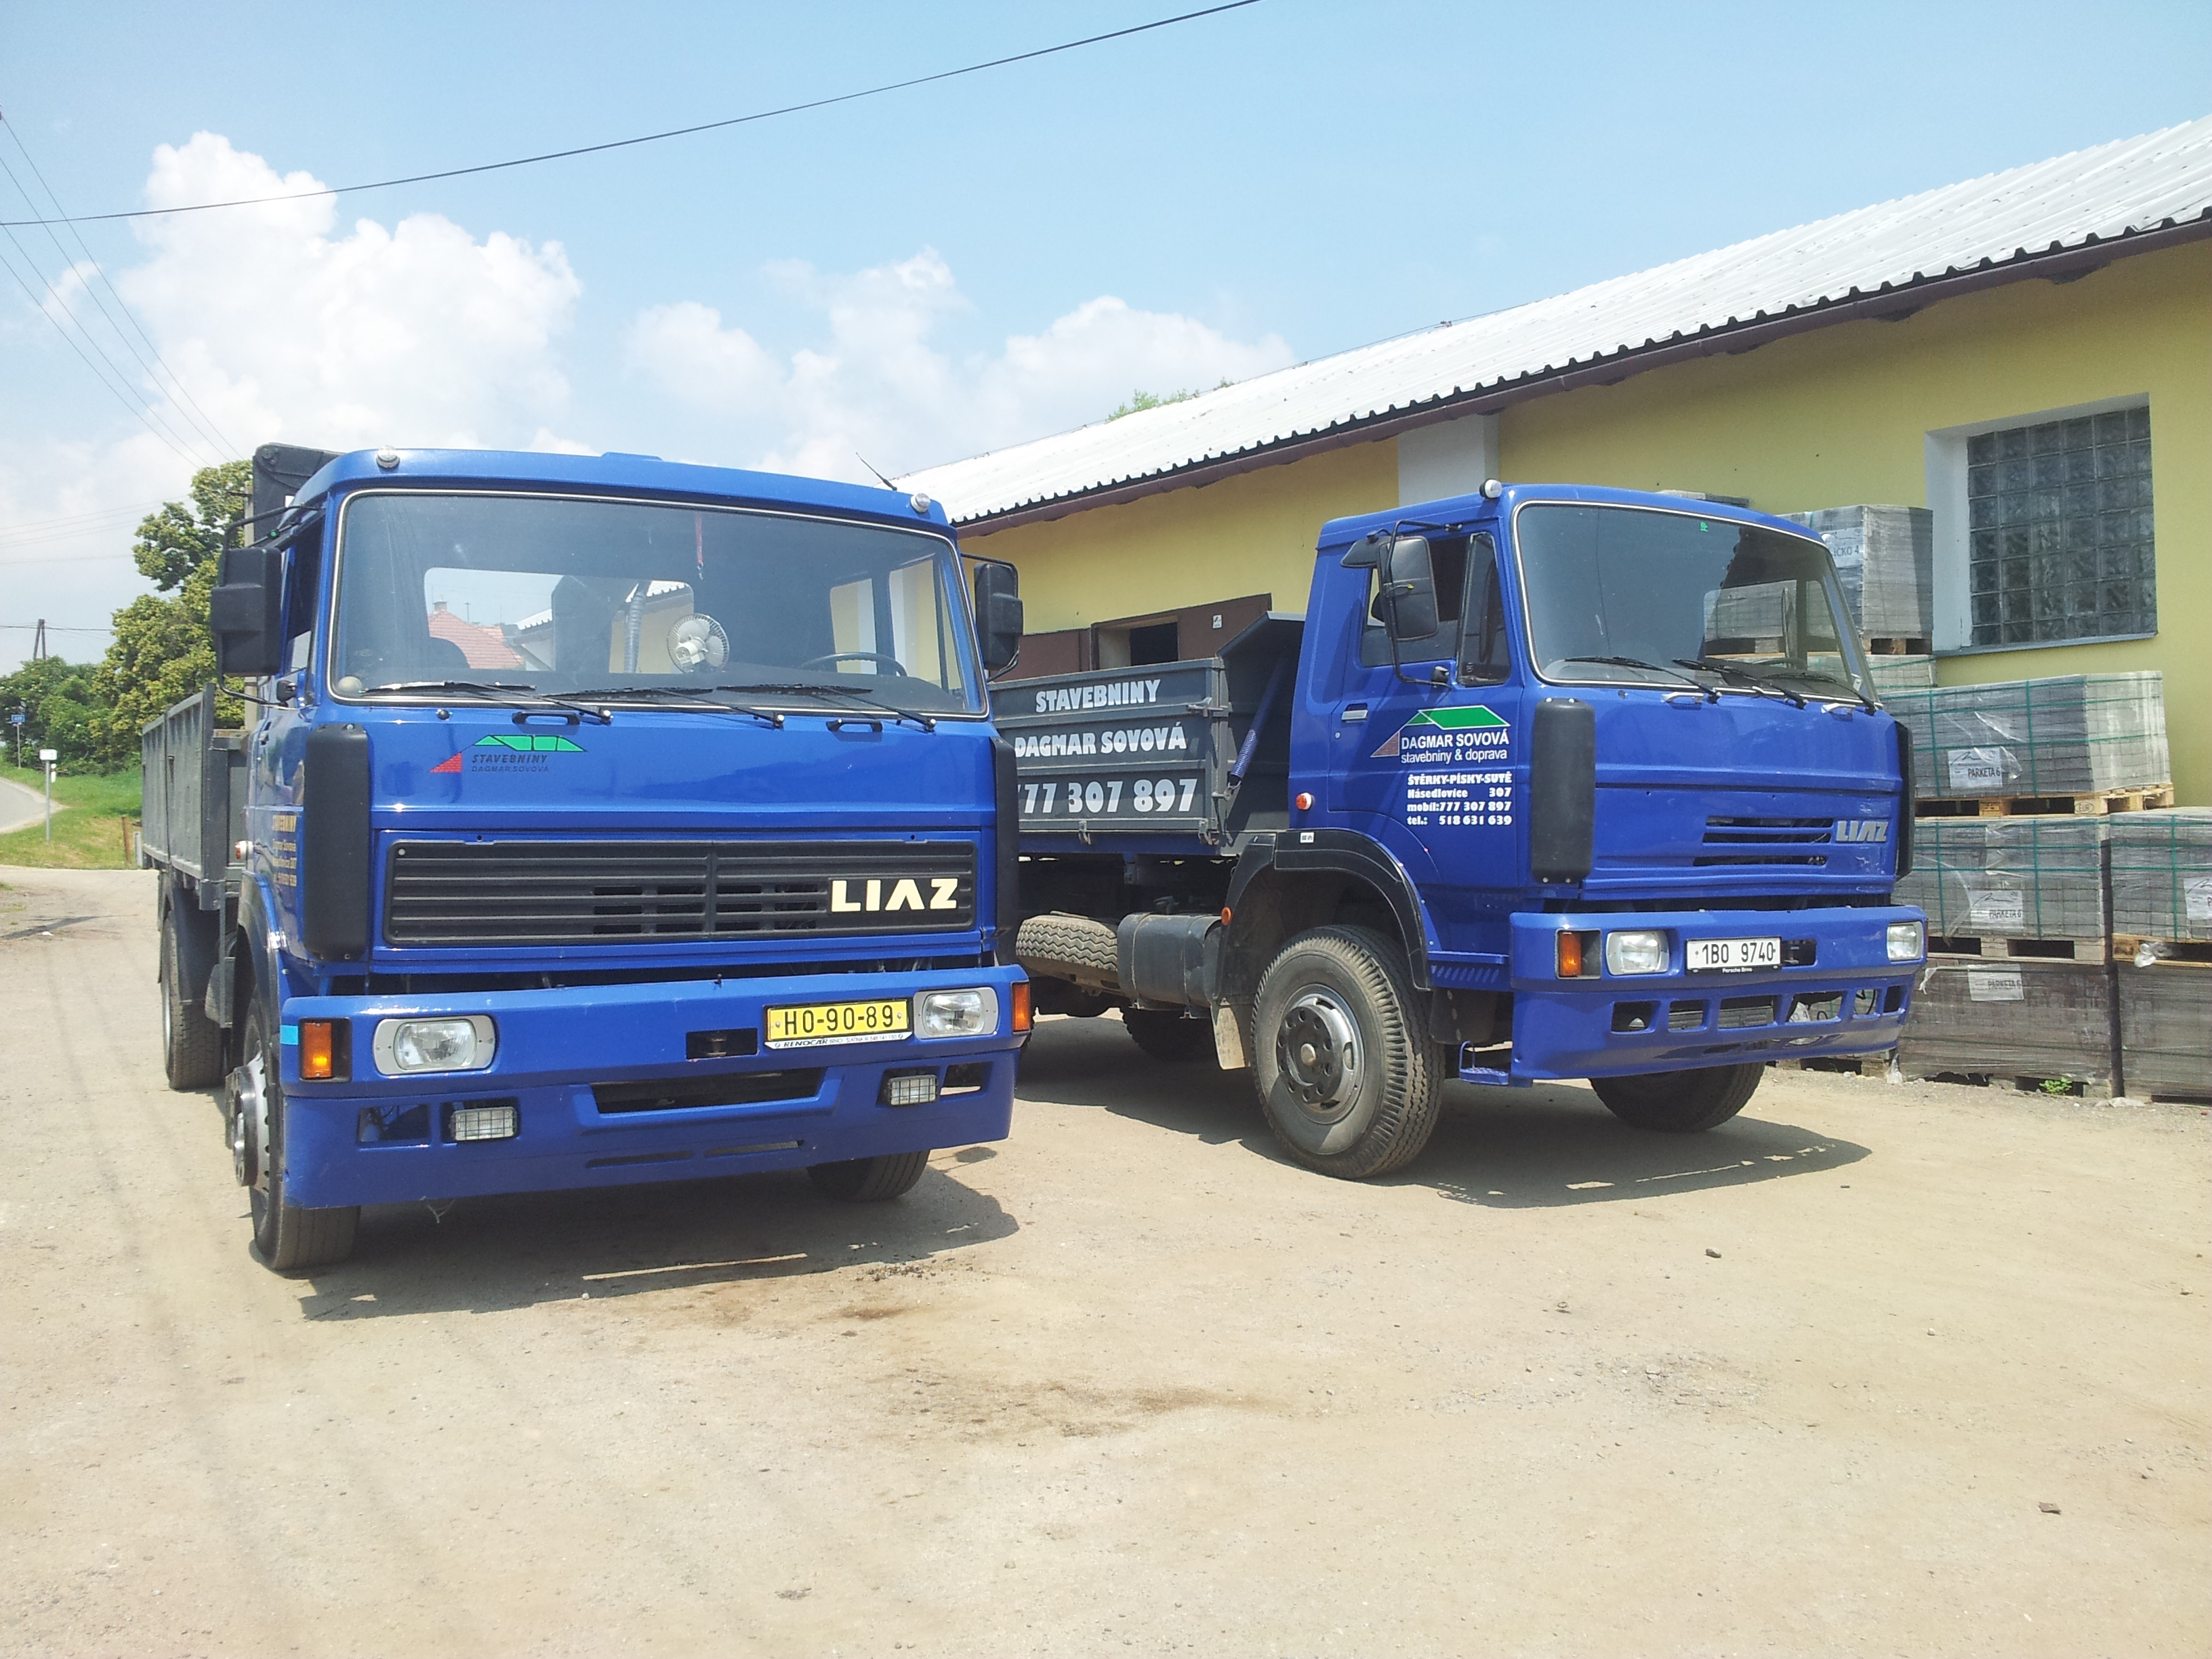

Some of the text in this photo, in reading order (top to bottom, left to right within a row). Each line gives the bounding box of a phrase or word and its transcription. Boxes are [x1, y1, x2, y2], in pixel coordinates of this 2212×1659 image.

[1854, 545, 1860, 554] 4
[1036, 679, 1161, 713] STAVEBNINY
[1015, 722, 1187, 758] DAGMAR SOVOVÁ
[1401, 729, 1510, 750] DAGMAR SOVOVÁ
[472, 754, 548, 764] STAVEBNINY
[1401, 747, 1508, 764] stavebniny & doprava
[1967, 767, 1995, 779] PARKETA
[1996, 766, 2001, 777] 6
[1017, 779, 1198, 814] 77 307 897
[1407, 787, 1512, 799] Násedlovice 307
[1463, 801, 1486, 811] 307
[1488, 801, 1512, 811] 897
[1406, 815, 1513, 825] tel.: 518 631 639
[1835, 820, 1889, 842] LIAZ
[831, 878, 958, 912] LIAZ
[1740, 941, 1774, 963] 9740
[785, 1004, 894, 1036] HO-90-89
[783, 1039, 828, 1047] RENOCAR
